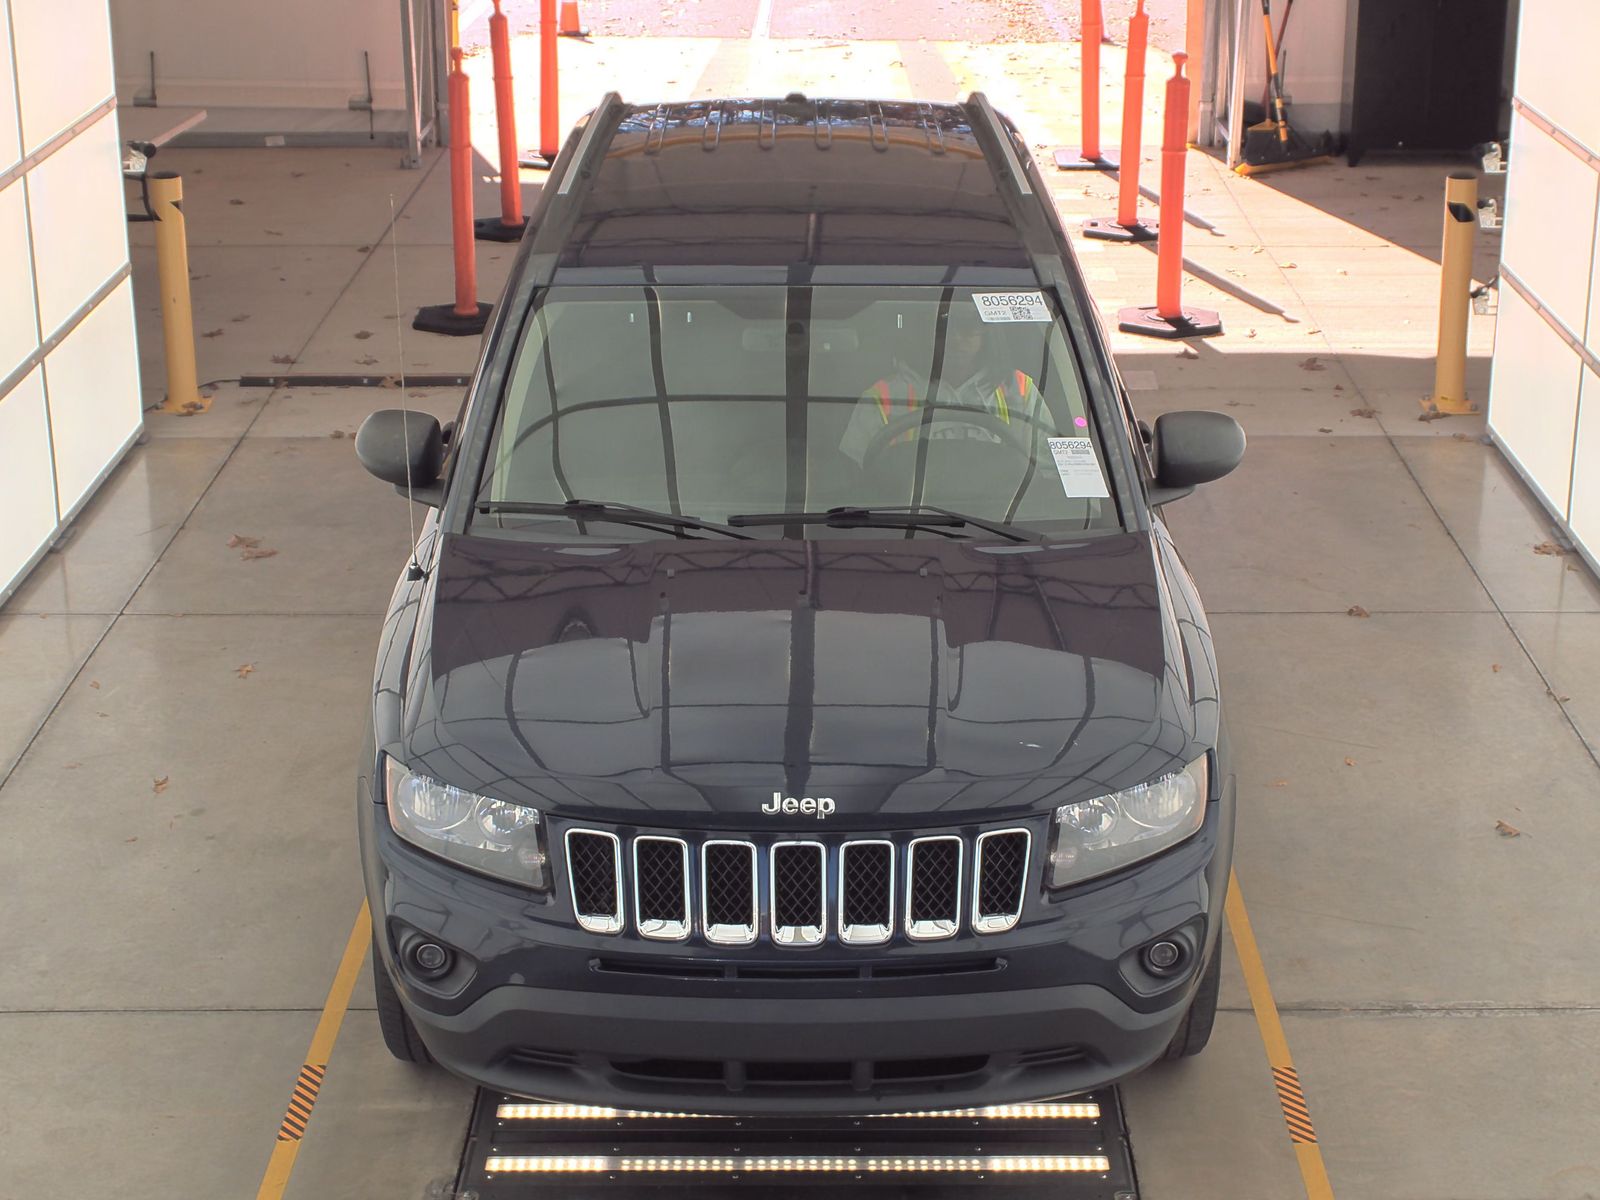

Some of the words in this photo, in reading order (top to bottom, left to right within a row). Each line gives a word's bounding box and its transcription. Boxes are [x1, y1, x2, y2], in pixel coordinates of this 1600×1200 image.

[981, 295, 1043, 306] 8056294
[1049, 441, 1092, 449] 8056294
[761, 792, 836, 819] Jeep
